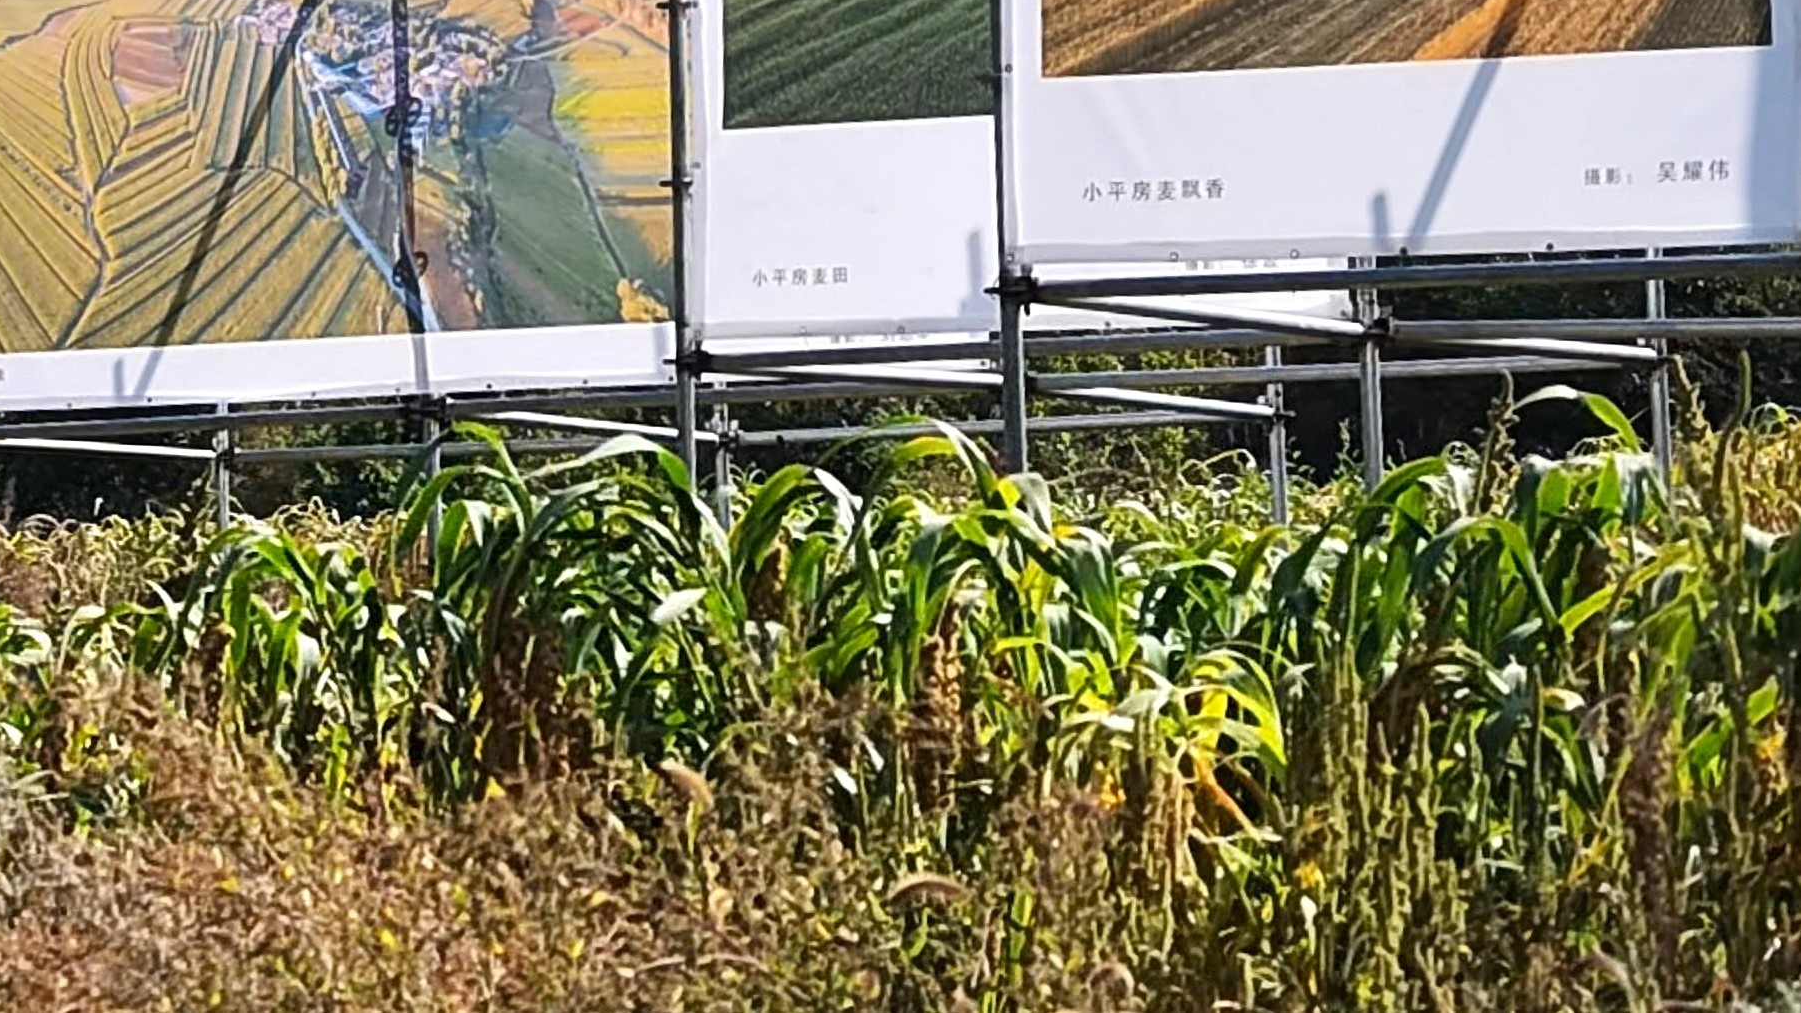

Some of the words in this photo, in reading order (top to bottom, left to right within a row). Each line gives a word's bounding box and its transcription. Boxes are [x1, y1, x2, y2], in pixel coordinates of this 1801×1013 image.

[1082, 177, 1224, 203] 小平房麦飘香
[752, 266, 849, 287] 小平房麦田
